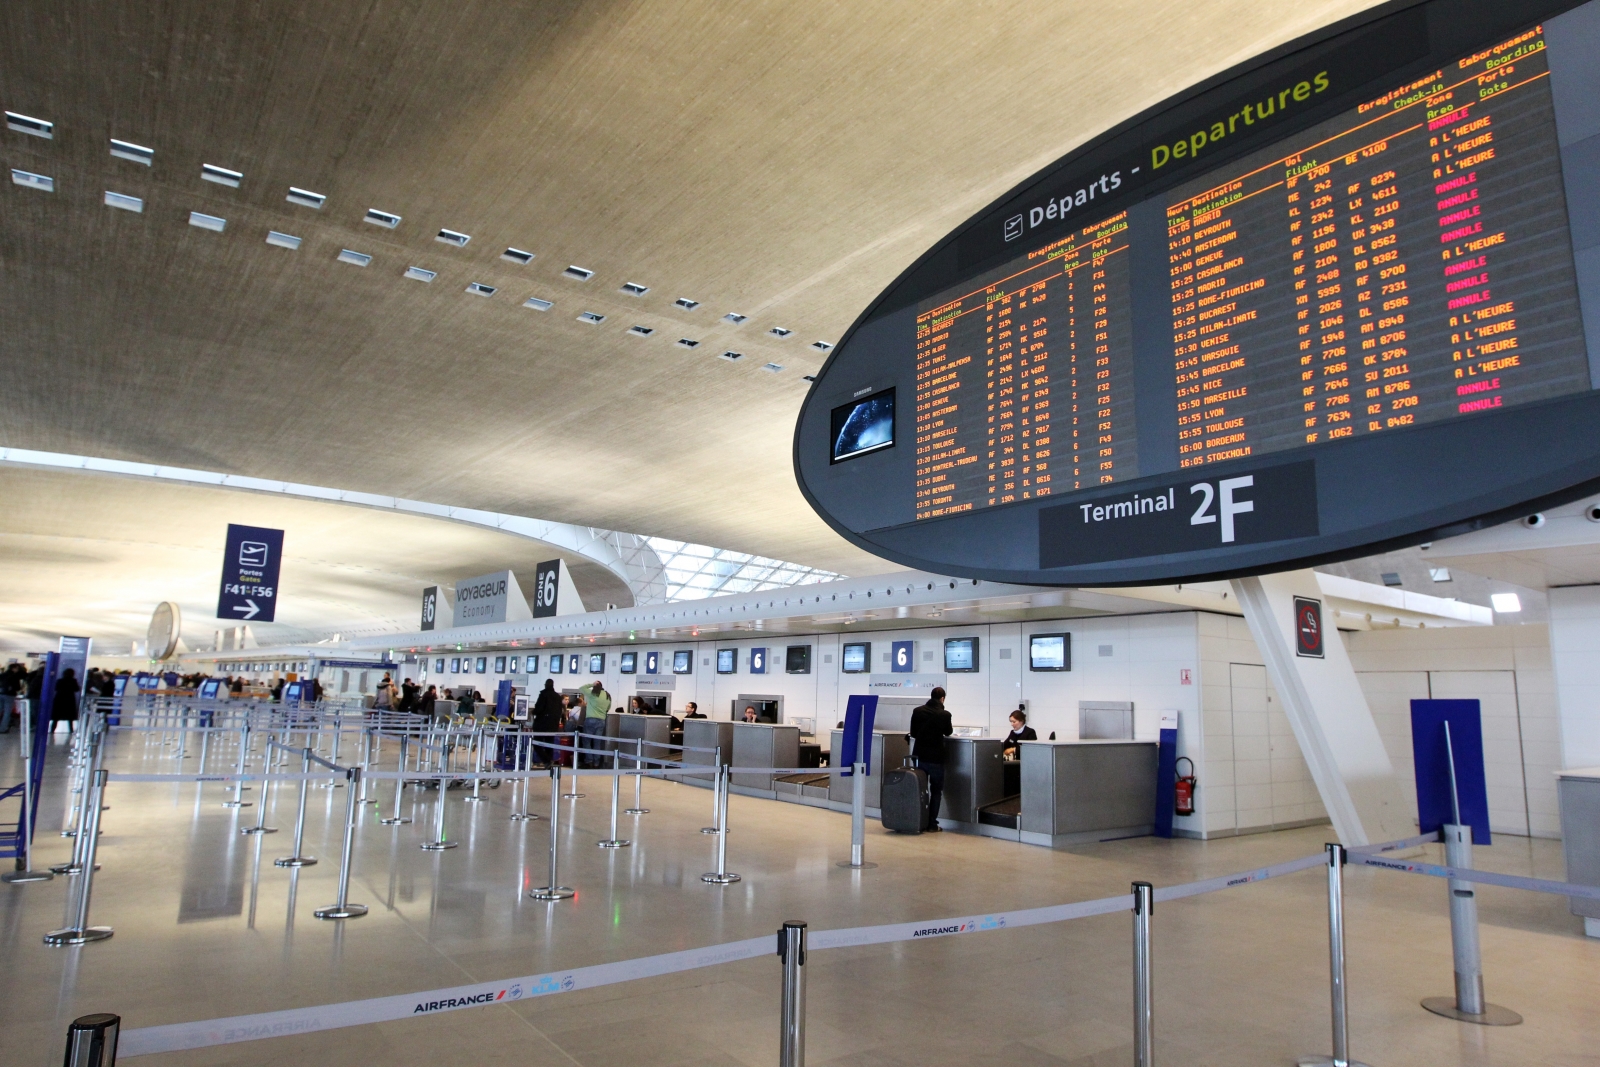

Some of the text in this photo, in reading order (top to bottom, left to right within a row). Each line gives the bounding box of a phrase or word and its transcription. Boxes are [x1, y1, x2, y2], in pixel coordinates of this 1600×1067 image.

[1394, 81, 1444, 110] Check-in
[1029, 171, 1122, 228] Départs
[1151, 70, 1330, 170] Departures
[1167, 63, 1515, 218] Heure Destination Vol Zone Porte
[1167, 214, 1185, 228] Time
[1193, 189, 1243, 217] Destination
[1286, 158, 1318, 180] Flight
[1480, 78, 1509, 99] Gate
[1168, 108, 1469, 237] 14:05 MADRID AF 1700 ANNULE
[1169, 235, 1190, 250] 14:10
[1194, 219, 1231, 240] BEYROUTH
[1288, 192, 1299, 204] ME
[1314, 180, 1331, 193] 242
[1169, 249, 1191, 264] 14:40
[1195, 231, 1236, 254] AMSTERDAM
[1289, 207, 1300, 218] KL
[1310, 194, 1332, 210] 1234
[1171, 173, 1477, 290] 15:25 CASABLANCA AF 1196 ANNULE
[1170, 262, 1192, 277] 15:00
[1196, 250, 1223, 267] GENEVE
[1290, 221, 1302, 232] AF
[1311, 209, 1334, 225] 2342
[1171, 189, 1478, 303] 15:25 MADRID AF 1800 ANNULE
[1093, 270, 1105, 281] F31
[1172, 206, 1480, 317] 15:25 ROME-FIUMICINO AF 2104 ANNULE
[1173, 223, 1482, 330] 15:25 BUCAREST AF 2488 ANNULE
[1095, 307, 1107, 318] F26
[1174, 256, 1486, 357] 15:30 VENISE AF 2026 ANNULE
[1174, 330, 1196, 344] 15:25
[1200, 311, 1256, 335] MILAN-LINATE
[1317, 285, 1340, 299] 5995
[1175, 273, 1488, 371] 15:45 VARSOVIE AF 1046 ANNULE
[1096, 345, 1108, 356] F21
[1176, 290, 1490, 384] 15:45 BARCELONE AF 1948 ANNULE
[1096, 358, 1109, 368] F33
[1097, 371, 1109, 381] F23
[1177, 385, 1199, 398] 15:45
[1203, 379, 1222, 391] NICE
[1301, 355, 1312, 366] AF
[1322, 346, 1345, 360] 7706
[1098, 396, 1110, 406] F25
[1177, 399, 1200, 412] 15:50
[1204, 388, 1247, 405] MARSEILLE
[1302, 371, 1313, 381] AF
[1323, 362, 1347, 376] 7666
[1178, 414, 1201, 426] 15:55
[1205, 408, 1224, 420] LYON
[1303, 386, 1315, 396] AF
[1325, 378, 1348, 391] 7646
[1098, 409, 1111, 419] F22
[1099, 422, 1111, 432] F52
[1179, 428, 1202, 440] 15:55
[1206, 418, 1244, 434] TOULOUSE
[1304, 402, 1316, 412] AF
[1326, 394, 1349, 407] 7786
[1180, 378, 1500, 454] 16:00 BORDEAUX AF 7634 ANNULE
[1099, 435, 1112, 445] F49
[1180, 395, 1502, 468] 16:05 STOCKHOLM AF 1062 ANNULE
[1100, 448, 1112, 458] F50
[1101, 474, 1113, 483] F34
[1080, 475, 1254, 543] Terminal 2F
[239, 568, 263, 577] Portes
[239, 575, 261, 583] Gates
[544, 570, 556, 607] 6
[224, 583, 246, 595] F41
[251, 585, 273, 597] F56
[427, 594, 435, 622] 6
[462, 604, 496, 620] Economy
[649, 656, 655, 670] 6
[754, 653, 762, 669] 6
[898, 647, 907, 666] 6
[1365, 859, 1407, 871] AIRFRANCE
[913, 925, 959, 937] AIRFRANCE
[413, 992, 494, 1014] AIRFRANCE
